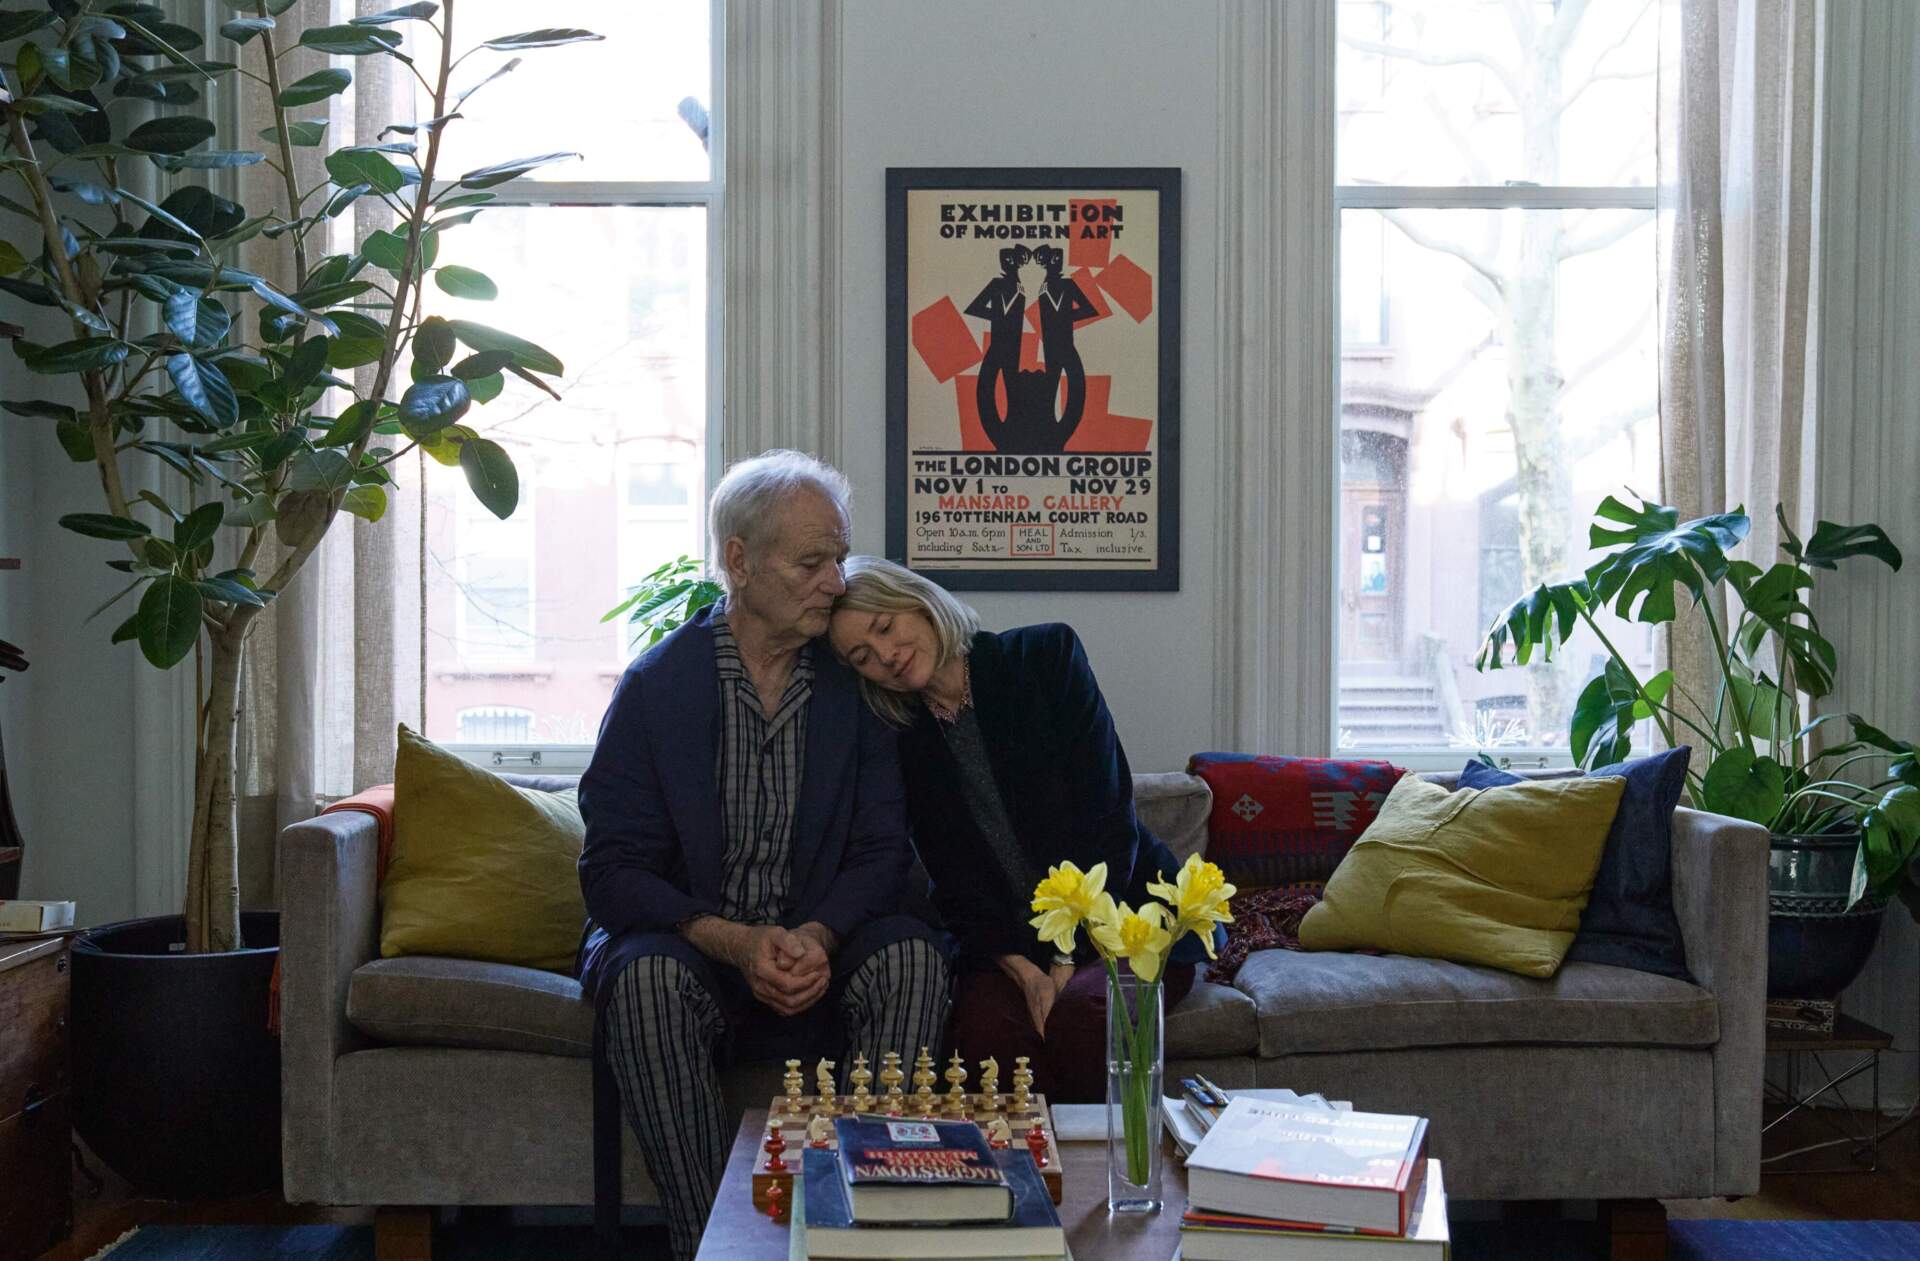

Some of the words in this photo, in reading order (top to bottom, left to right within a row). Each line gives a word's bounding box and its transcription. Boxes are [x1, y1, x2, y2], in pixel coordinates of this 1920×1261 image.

[940, 224, 967, 239] OF
[974, 224, 1070, 239] MODERN
[1080, 225, 1123, 239] ART
[915, 461, 946, 472] THE
[950, 456, 1060, 476] LONDON
[1066, 457, 1152, 477] GROUP
[915, 478, 967, 494] NOV
[976, 478, 984, 494] 1
[992, 486, 1008, 494] TO
[1070, 479, 1117, 494] NOV
[1125, 479, 1151, 494] 29
[938, 495, 1030, 510] MANSARD
[1043, 495, 1124, 510] GALLERY
[916, 511, 940, 524] 196
[945, 511, 1041, 523] TOTTENHAM
[1049, 511, 1099, 524] COURT
[1106, 512, 1148, 524] ROAD
[916, 527, 944, 540] Open
[1019, 528, 1048, 537] HEAL
[1060, 528, 1113, 538] Admission
[917, 541, 962, 554] including
